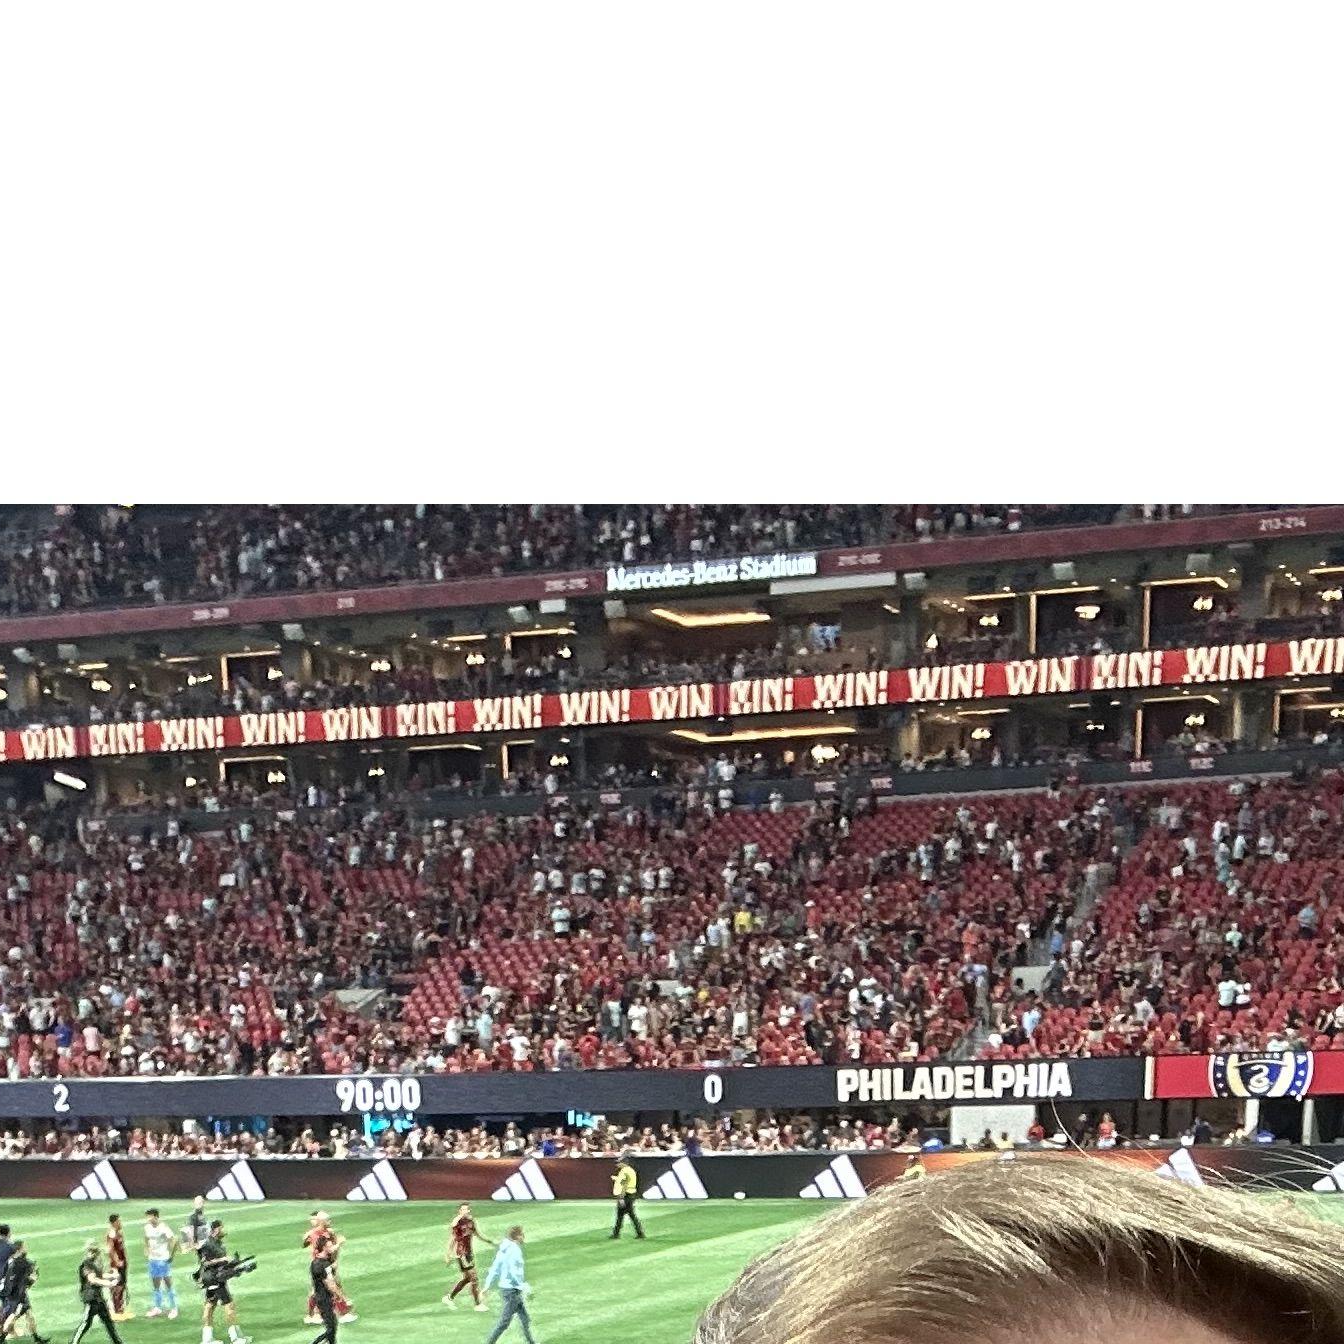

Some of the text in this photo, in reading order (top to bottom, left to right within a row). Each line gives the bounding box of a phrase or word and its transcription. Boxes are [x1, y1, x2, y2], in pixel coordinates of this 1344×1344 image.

[608, 562, 738, 591] Mercedes-Benz
[740, 554, 817, 581] Stadium
[161, 718, 224, 750] WIN!
[240, 712, 305, 745] WIN!
[473, 695, 541, 731] WIN!
[560, 690, 630, 725] WIN!
[813, 672, 887, 708] WIN!
[908, 664, 984, 701] WIN!
[1183, 644, 1266, 682] WIN!
[52, 1083, 70, 1113] 2
[336, 1078, 422, 1112] 90:00
[703, 1073, 723, 1104] 0
[837, 1063, 1073, 1101] PHILADELPHIA
